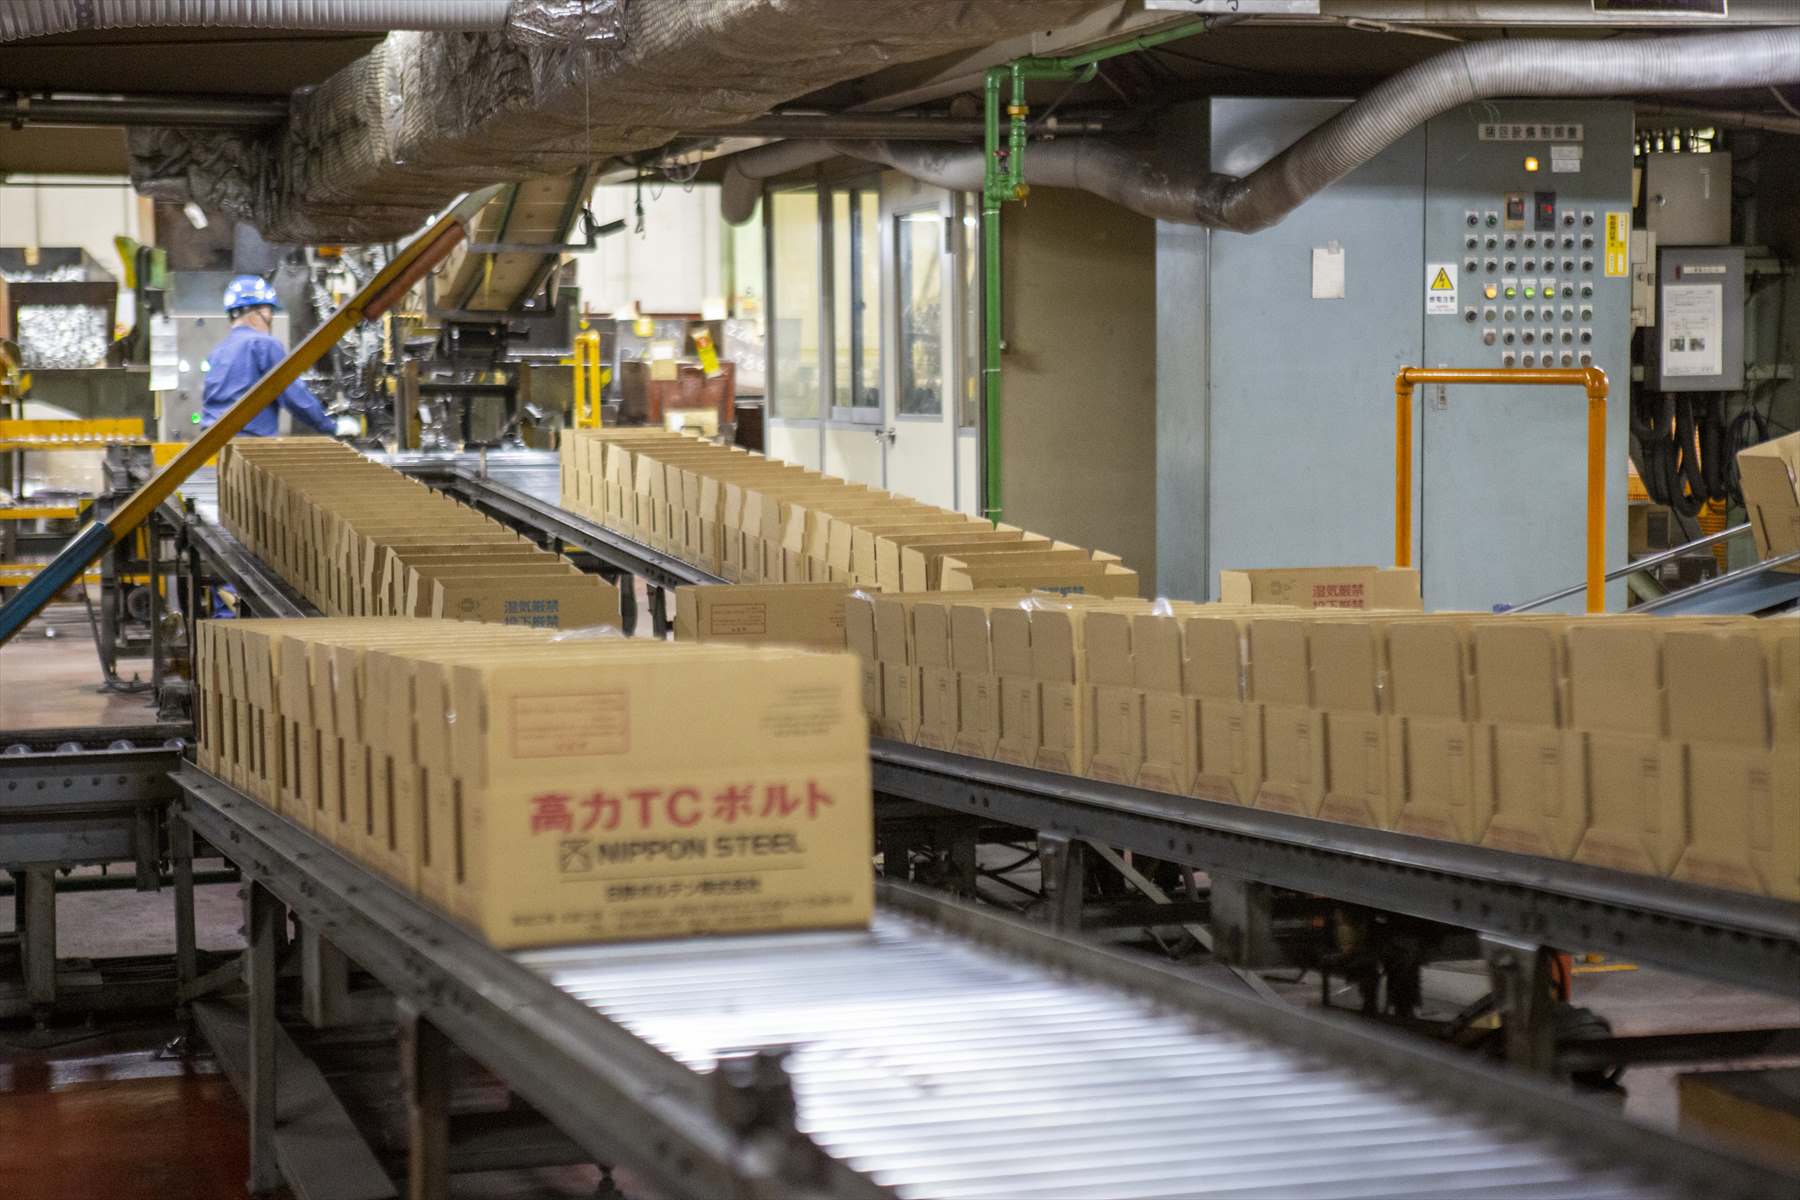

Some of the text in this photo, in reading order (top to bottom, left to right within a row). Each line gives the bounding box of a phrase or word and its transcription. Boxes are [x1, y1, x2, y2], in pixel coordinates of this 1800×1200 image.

[1312, 583, 1364, 598] 湿気厳禁
[504, 599, 560, 613] 湿気厳禁
[530, 779, 834, 834] 高力TCボルト
[598, 832, 806, 863] NIPPON STEEL
